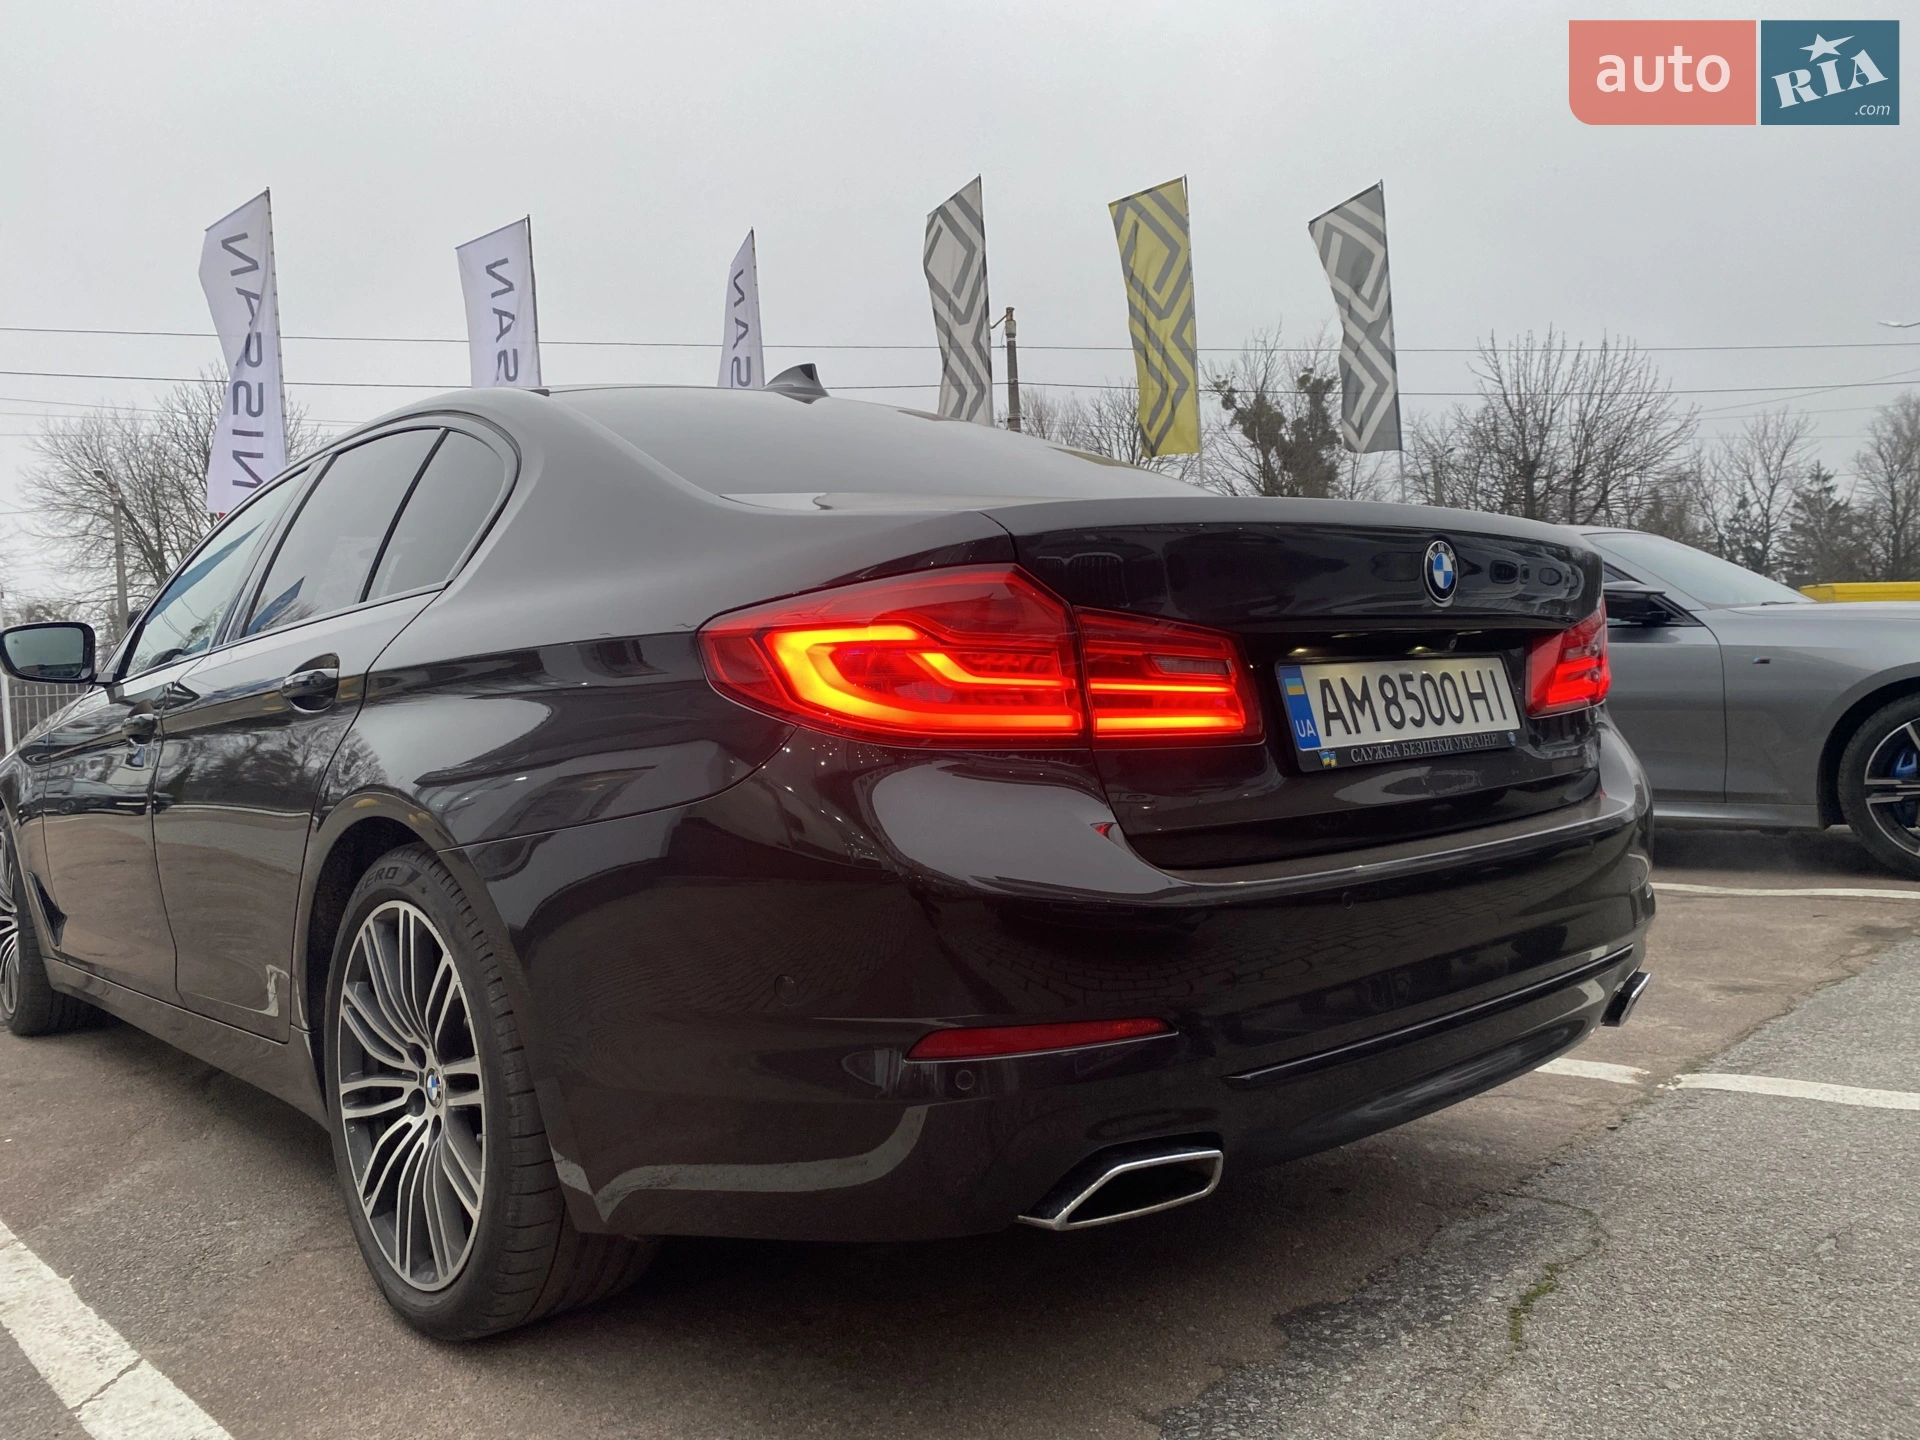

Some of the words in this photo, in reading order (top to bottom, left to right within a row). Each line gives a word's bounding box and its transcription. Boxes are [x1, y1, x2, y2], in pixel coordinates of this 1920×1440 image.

[1428, 543, 1456, 562] BMW
[1296, 720, 1317, 739] UA
[1350, 744, 1401, 763] СЛУЖБА
[1401, 737, 1454, 757] БЕЗПЕКИ
